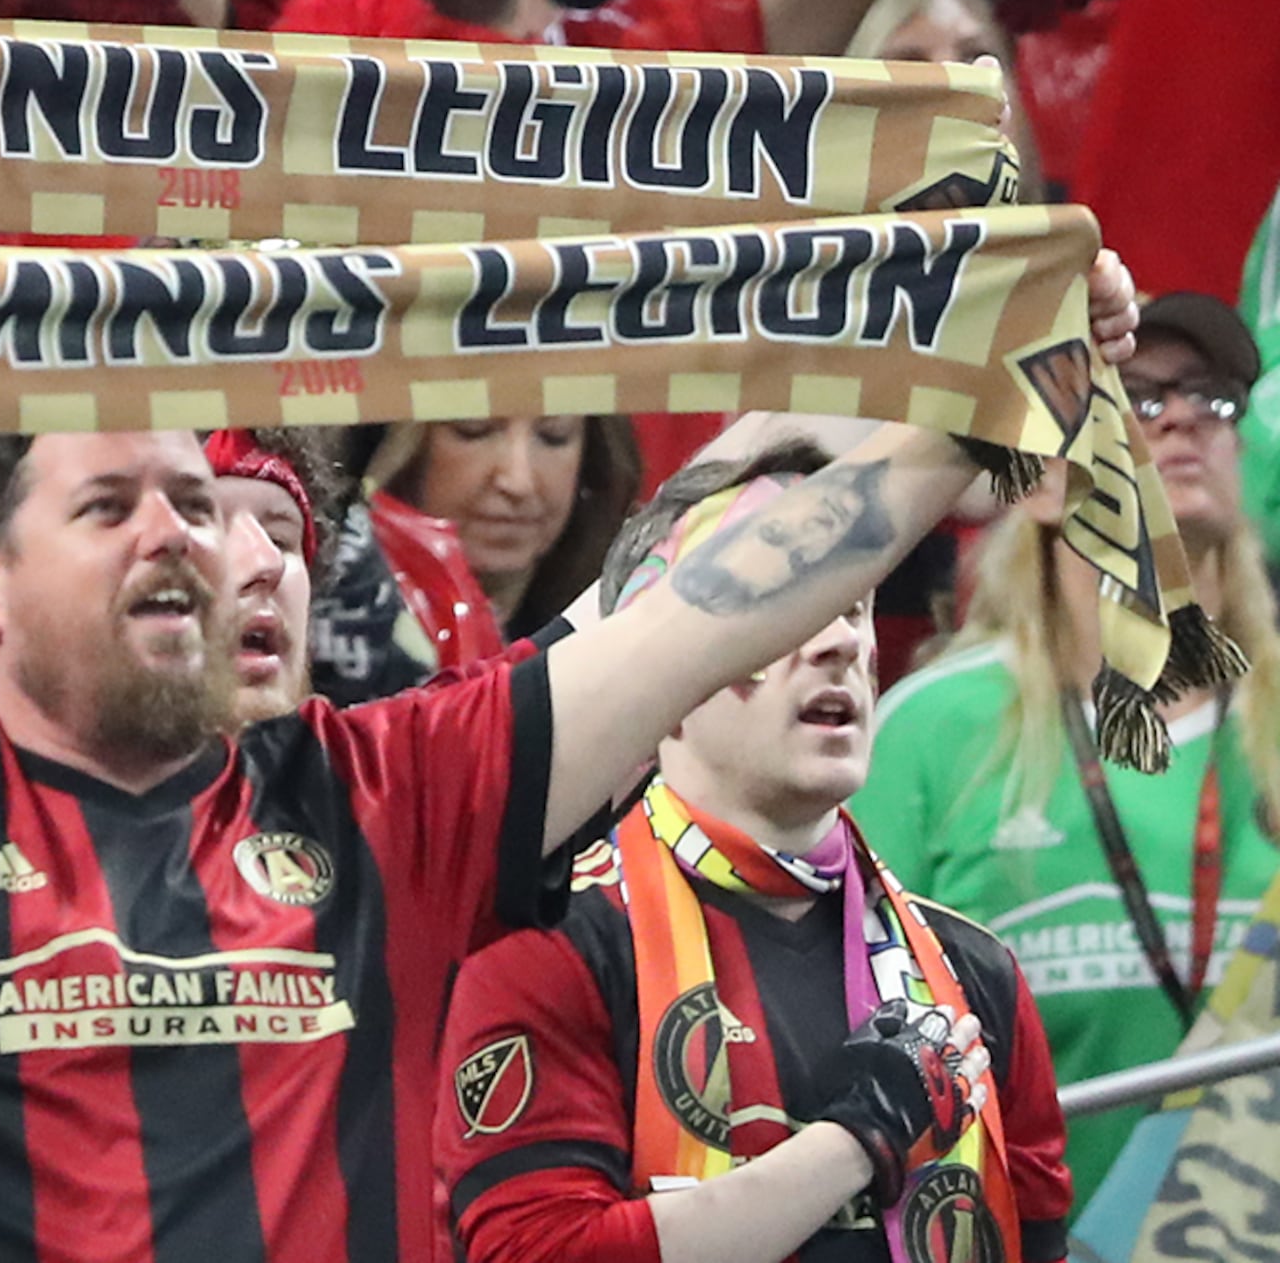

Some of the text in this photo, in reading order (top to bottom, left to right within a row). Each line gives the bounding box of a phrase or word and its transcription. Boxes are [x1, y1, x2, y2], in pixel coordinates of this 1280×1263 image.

[332, 53, 835, 206] LEGION
[156, 166, 242, 209] 2018
[452, 214, 987, 353] LEGION
[270, 356, 366, 398] 2018
[216, 971, 337, 1007] FAMILY
[28, 1014, 323, 1041] INSURANCE
[458, 1054, 498, 1086] MLS
